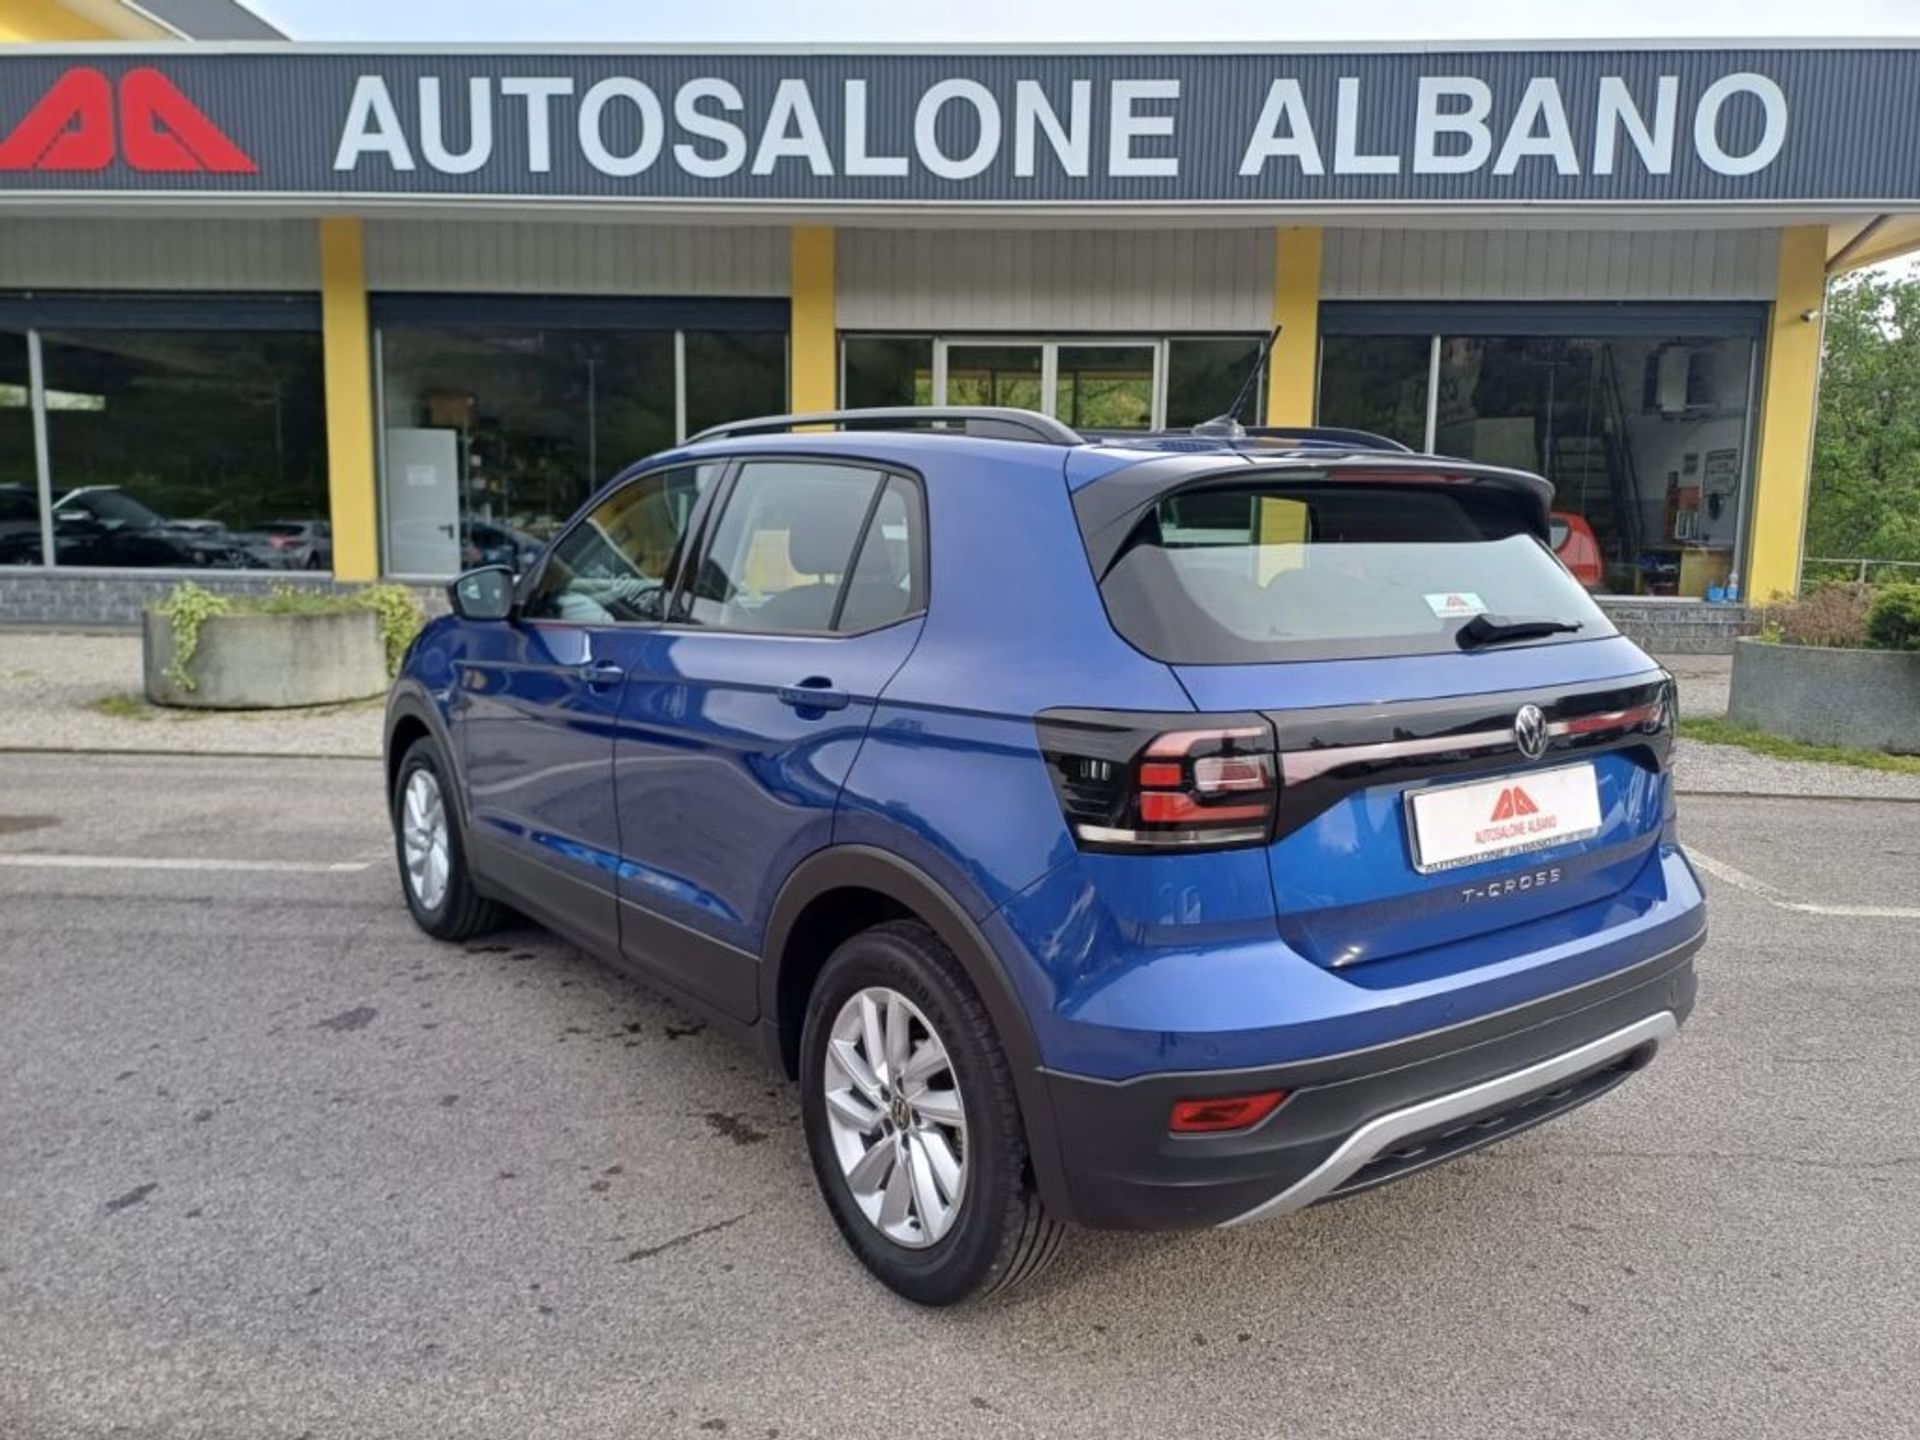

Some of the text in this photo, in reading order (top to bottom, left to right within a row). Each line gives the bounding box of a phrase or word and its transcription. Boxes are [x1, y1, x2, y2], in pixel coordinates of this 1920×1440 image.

[333, 72, 1788, 179] AUTOSALONE ALBANO
[1462, 868, 1561, 903] T-CROSS
